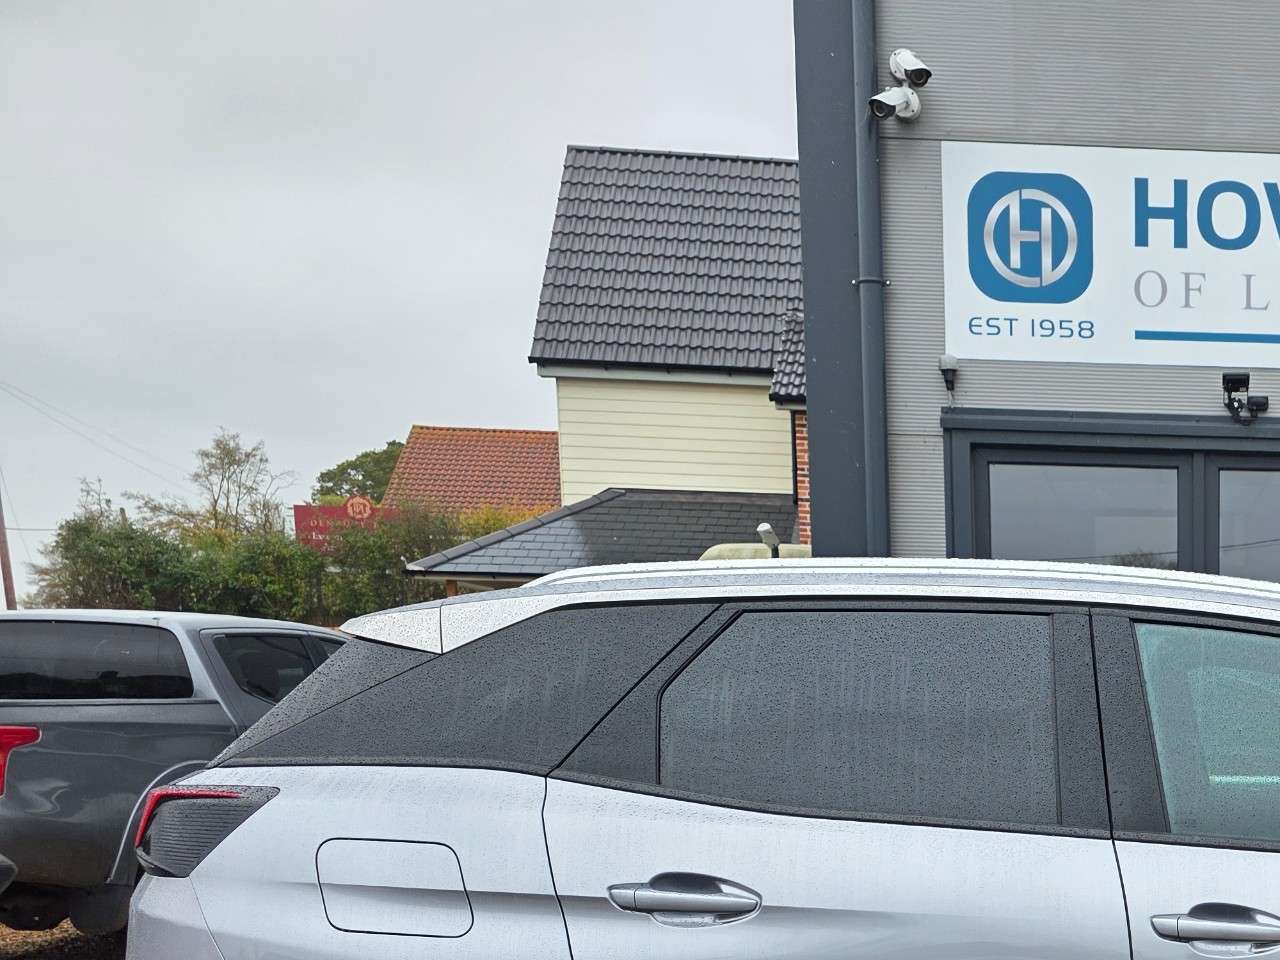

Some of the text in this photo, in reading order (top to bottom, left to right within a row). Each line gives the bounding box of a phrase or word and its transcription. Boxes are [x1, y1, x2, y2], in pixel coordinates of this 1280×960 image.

[1134, 270, 1206, 308] OF
[968, 317, 1095, 339] EST 1958
